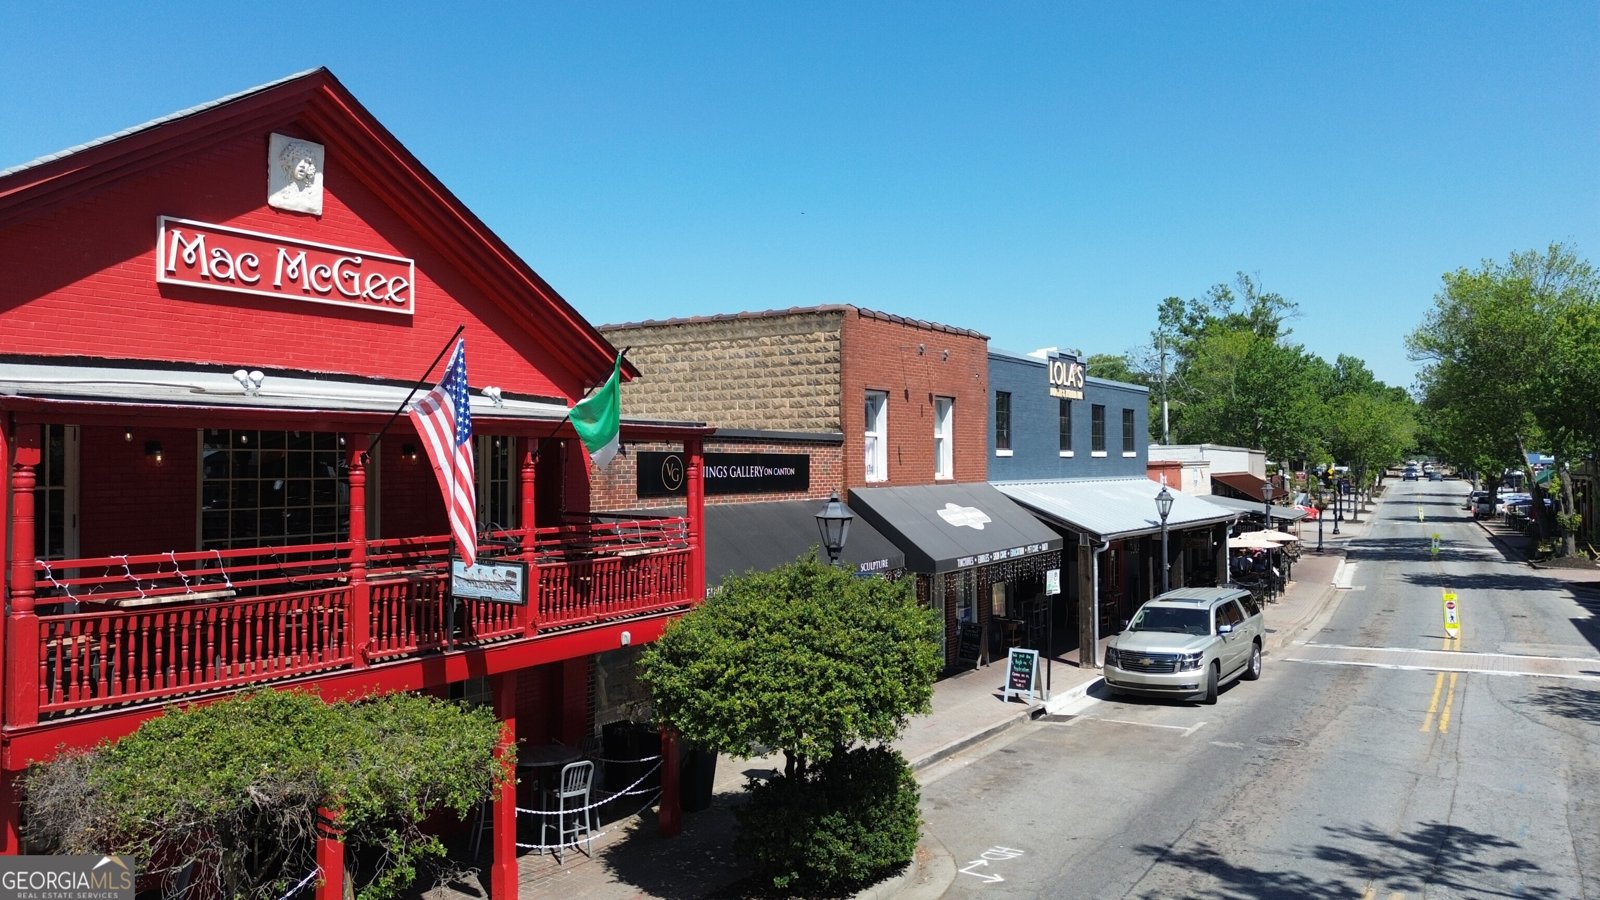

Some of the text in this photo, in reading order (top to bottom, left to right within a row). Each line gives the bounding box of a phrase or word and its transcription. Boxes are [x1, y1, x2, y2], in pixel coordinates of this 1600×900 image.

[166, 229, 410, 303] Mac McGee
[1050, 360, 1084, 389] LOLA'S
[666, 463, 680, 481] VG
[702, 465, 796, 478] INGS GALLERY ON CANTON
[861, 559, 889, 572] SCULPTURE
